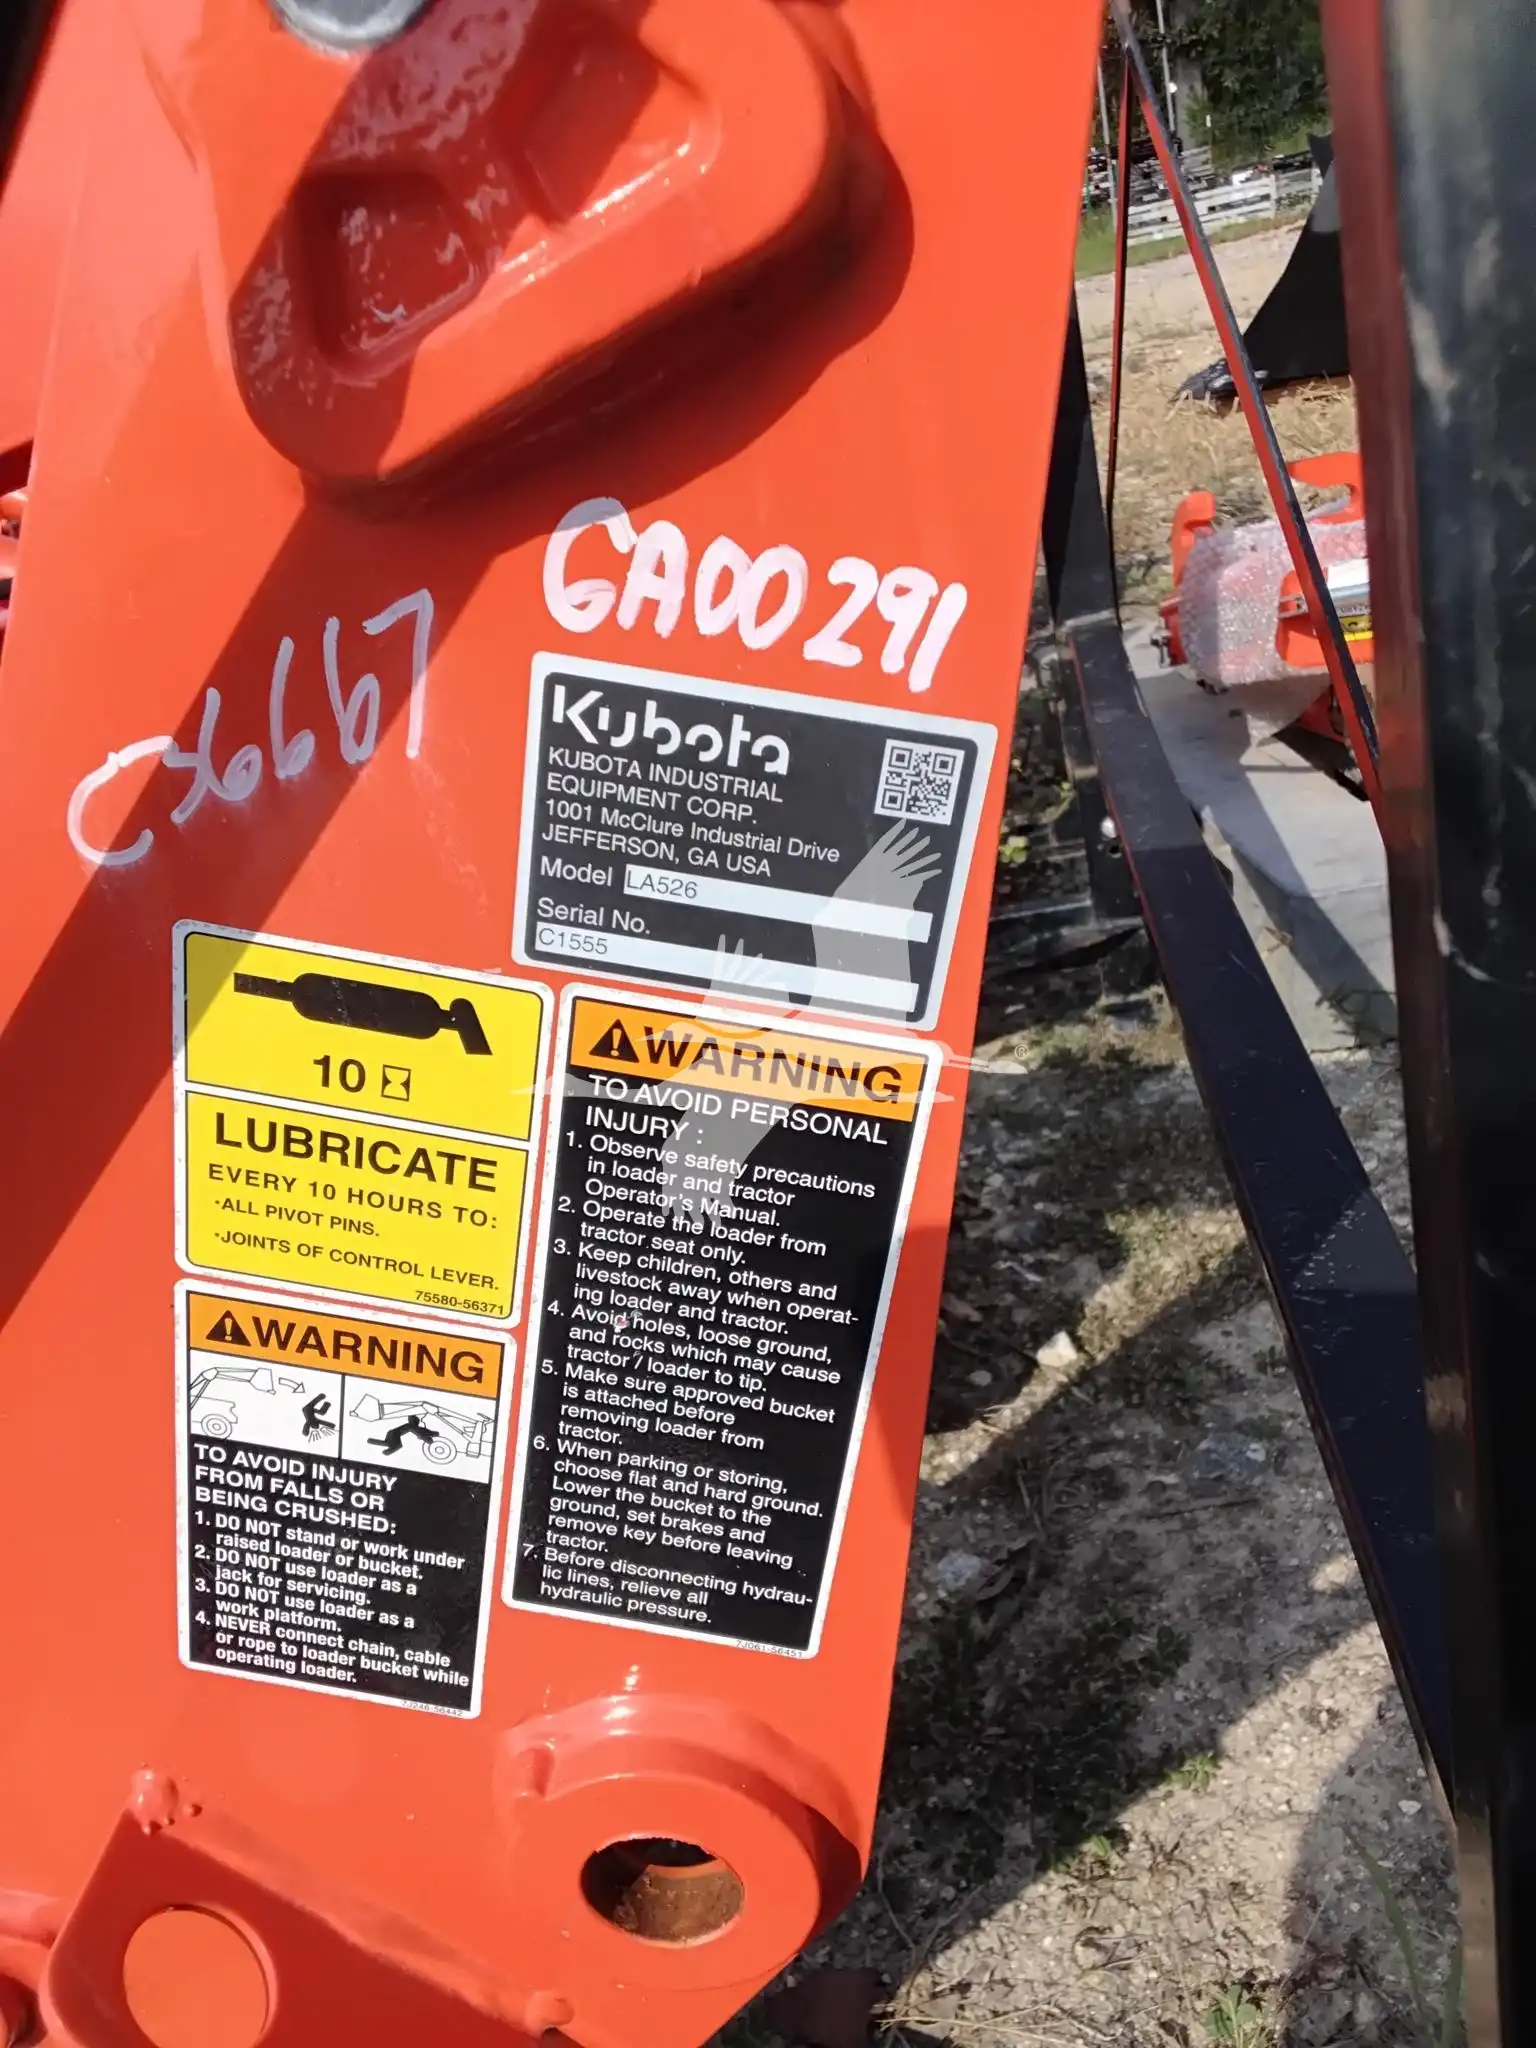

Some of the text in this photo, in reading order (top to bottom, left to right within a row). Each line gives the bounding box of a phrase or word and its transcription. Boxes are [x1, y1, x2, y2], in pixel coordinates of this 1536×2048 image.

[552, 684, 790, 776] Kubota
[547, 772, 757, 824] EQUIPMENT CORP.
[548, 746, 783, 803] KUBOTA INDUSTRIAL
[542, 823, 771, 877] JEFFERSON, GA USA
[546, 798, 840, 862] 1001 McClure Industrial Drive
[541, 855, 697, 899] Model LA526
[537, 897, 650, 934] Serial No.
[538, 927, 608, 955] C1555
[313, 1054, 367, 1093] 10
[643, 1026, 902, 1105] WARNING
[586, 1105, 689, 1141] INJURY
[588, 1074, 888, 1145] TO AVOID PERSONAL
[216, 1112, 497, 1192] LUBRICATE
[590, 1134, 875, 1198] Observe safety precautions
[209, 1163, 297, 1193] EVERY
[309, 1181, 336, 1200] 10
[347, 1187, 442, 1219] HOURS
[585, 1178, 780, 1227] Operator's Manual.
[612, 1160, 796, 1206] loader and tractor
[265, 1204, 324, 1226] PIVOT
[330, 1215, 379, 1236] PINS.
[580, 1221, 746, 1266] tractor seat only.
[583, 1199, 826, 1256] Operate the loader from
[329, 1248, 424, 1277] CONTROL
[430, 1266, 498, 1290] LEVER.
[576, 1262, 858, 1325] livestock away when operat-
[578, 1241, 837, 1301] Keep children, others and
[415, 1290, 503, 1315] 75580-56371
[574, 1282, 788, 1334] ing loader and tractor.
[252, 1316, 483, 1384] WARNING
[569, 1327, 841, 1384] and rocks which may cause
[571, 1303, 831, 1365] Avoid holes, loose ground,
[565, 1362, 835, 1423] Make sure approved bucket
[567, 1343, 767, 1393] tractor loader tip.
[560, 1404, 764, 1450] removing loader from
[584, 1388, 735, 1425] attached before
[558, 1420, 622, 1445] tractor.
[195, 1443, 398, 1492] TO AVOID INJURY
[195, 1464, 384, 1512] FROM FALLS OR
[554, 1458, 823, 1517] choose flat and hard ground.
[557, 1438, 787, 1494] When parking storing,
[195, 1485, 396, 1535] BEING CRUSHED:
[550, 1496, 766, 1544] ground, brakes and
[552, 1475, 772, 1527] Lower bucket the
[216, 1533, 423, 1580] raised loader bucket.
[245, 1518, 466, 1569] NOT stand work under
[546, 1529, 608, 1554] tractor.
[548, 1514, 793, 1570] remove key before leaving
[214, 1564, 371, 1606] jack servicing.
[245, 1552, 377, 1588] NOT use loader
[544, 1546, 813, 1605] Before disconnecting hydrau-
[567, 1568, 682, 1600] lines, relieve
[215, 1599, 342, 1632] work platform.
[245, 1585, 375, 1621] NOT loader
[540, 1581, 711, 1623] hydraulic pressure.
[215, 1613, 451, 1667] NEVER connect chain, cable
[238, 1636, 469, 1687] rope loader bucket while
[215, 1648, 357, 1683] operating loader.
